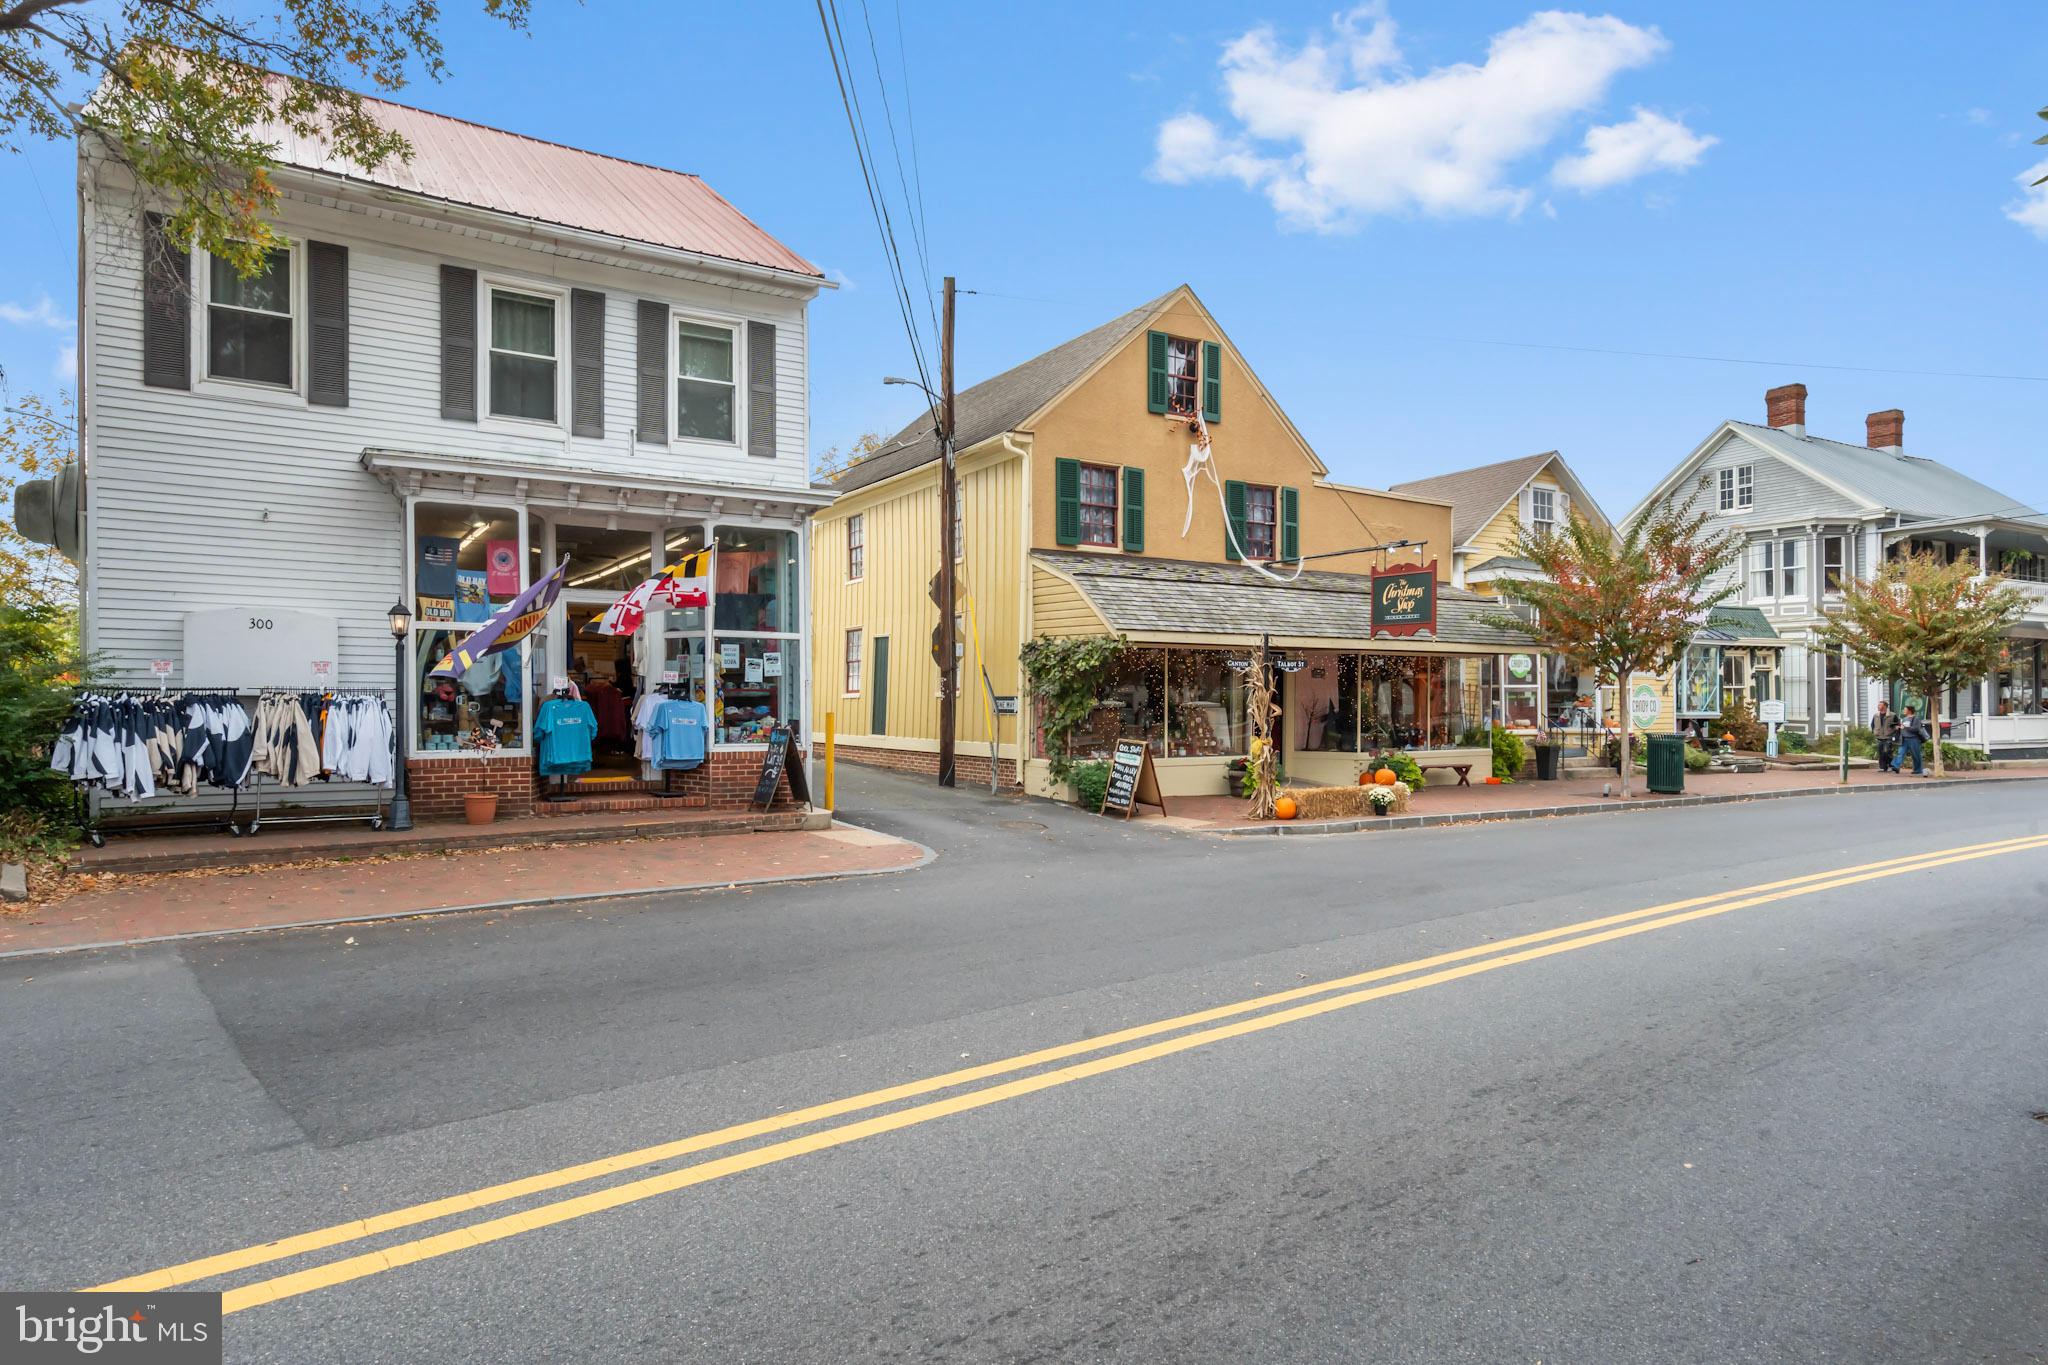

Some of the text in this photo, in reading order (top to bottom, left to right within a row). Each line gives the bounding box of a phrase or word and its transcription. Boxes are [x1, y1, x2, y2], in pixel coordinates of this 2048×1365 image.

[1383, 583, 1425, 605] Christmas
[435, 600, 449, 608] PUT
[1391, 596, 1416, 614] Shop
[249, 618, 273, 630] 300
[1632, 700, 1657, 713] CANDY CO
